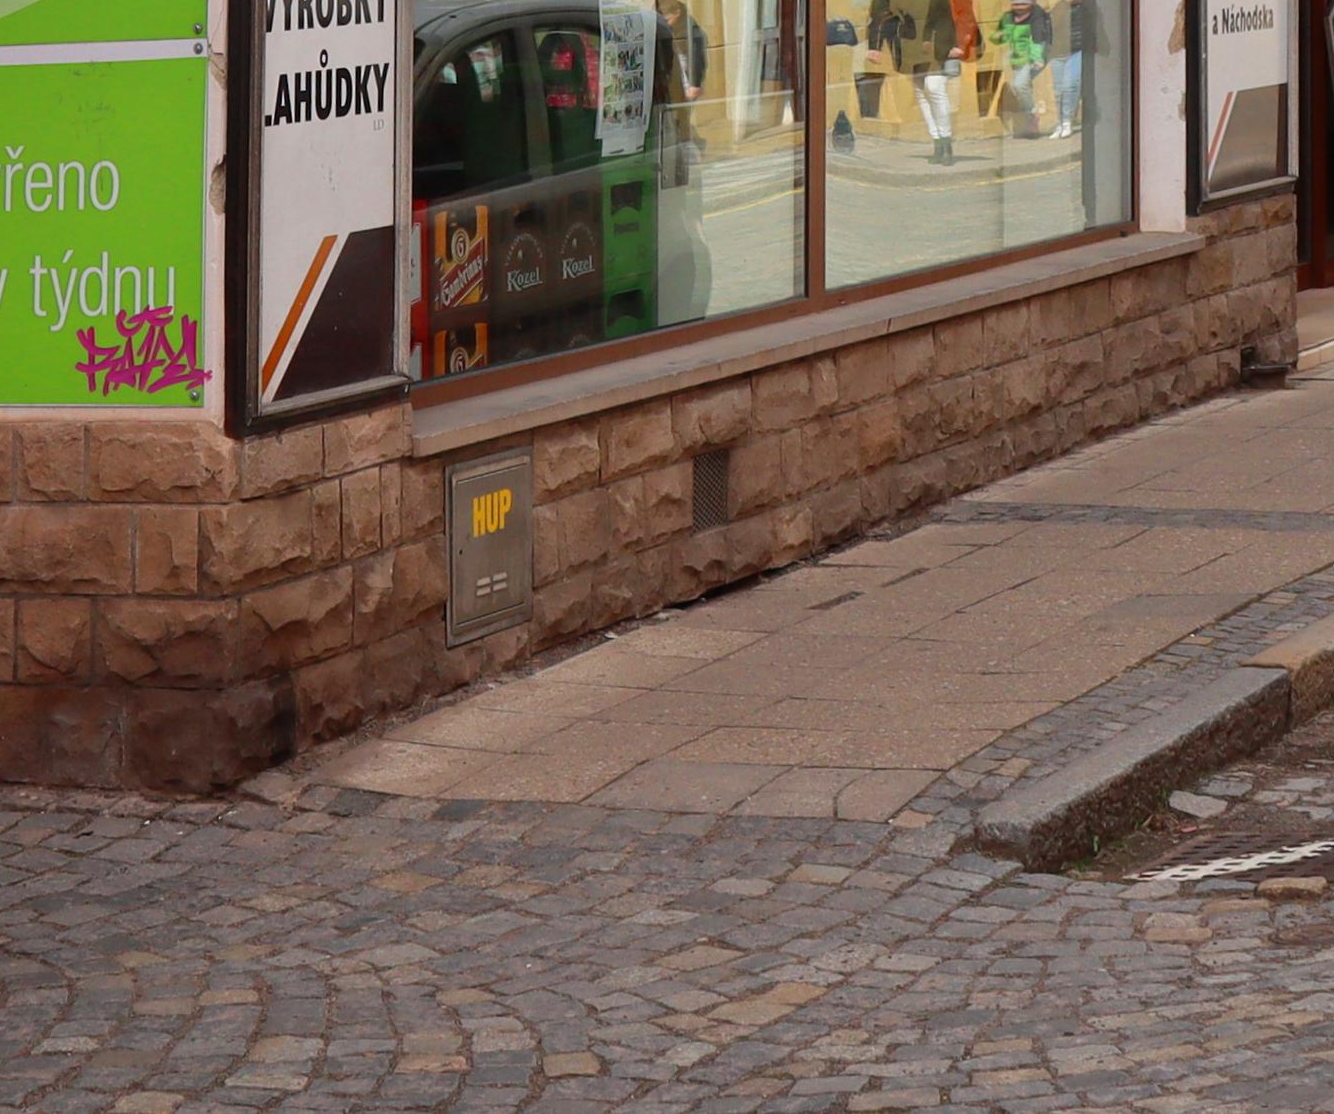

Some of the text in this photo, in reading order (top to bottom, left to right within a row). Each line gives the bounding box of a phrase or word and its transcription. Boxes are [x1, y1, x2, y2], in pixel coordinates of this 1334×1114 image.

[1212, 3, 1274, 35] a Náchodska
[264, 48, 390, 126] AHŮDKY
[506, 266, 543, 293] Kozel
[562, 254, 596, 280] Kozel
[29, 249, 175, 332] týdnu
[472, 488, 512, 537] HUP
